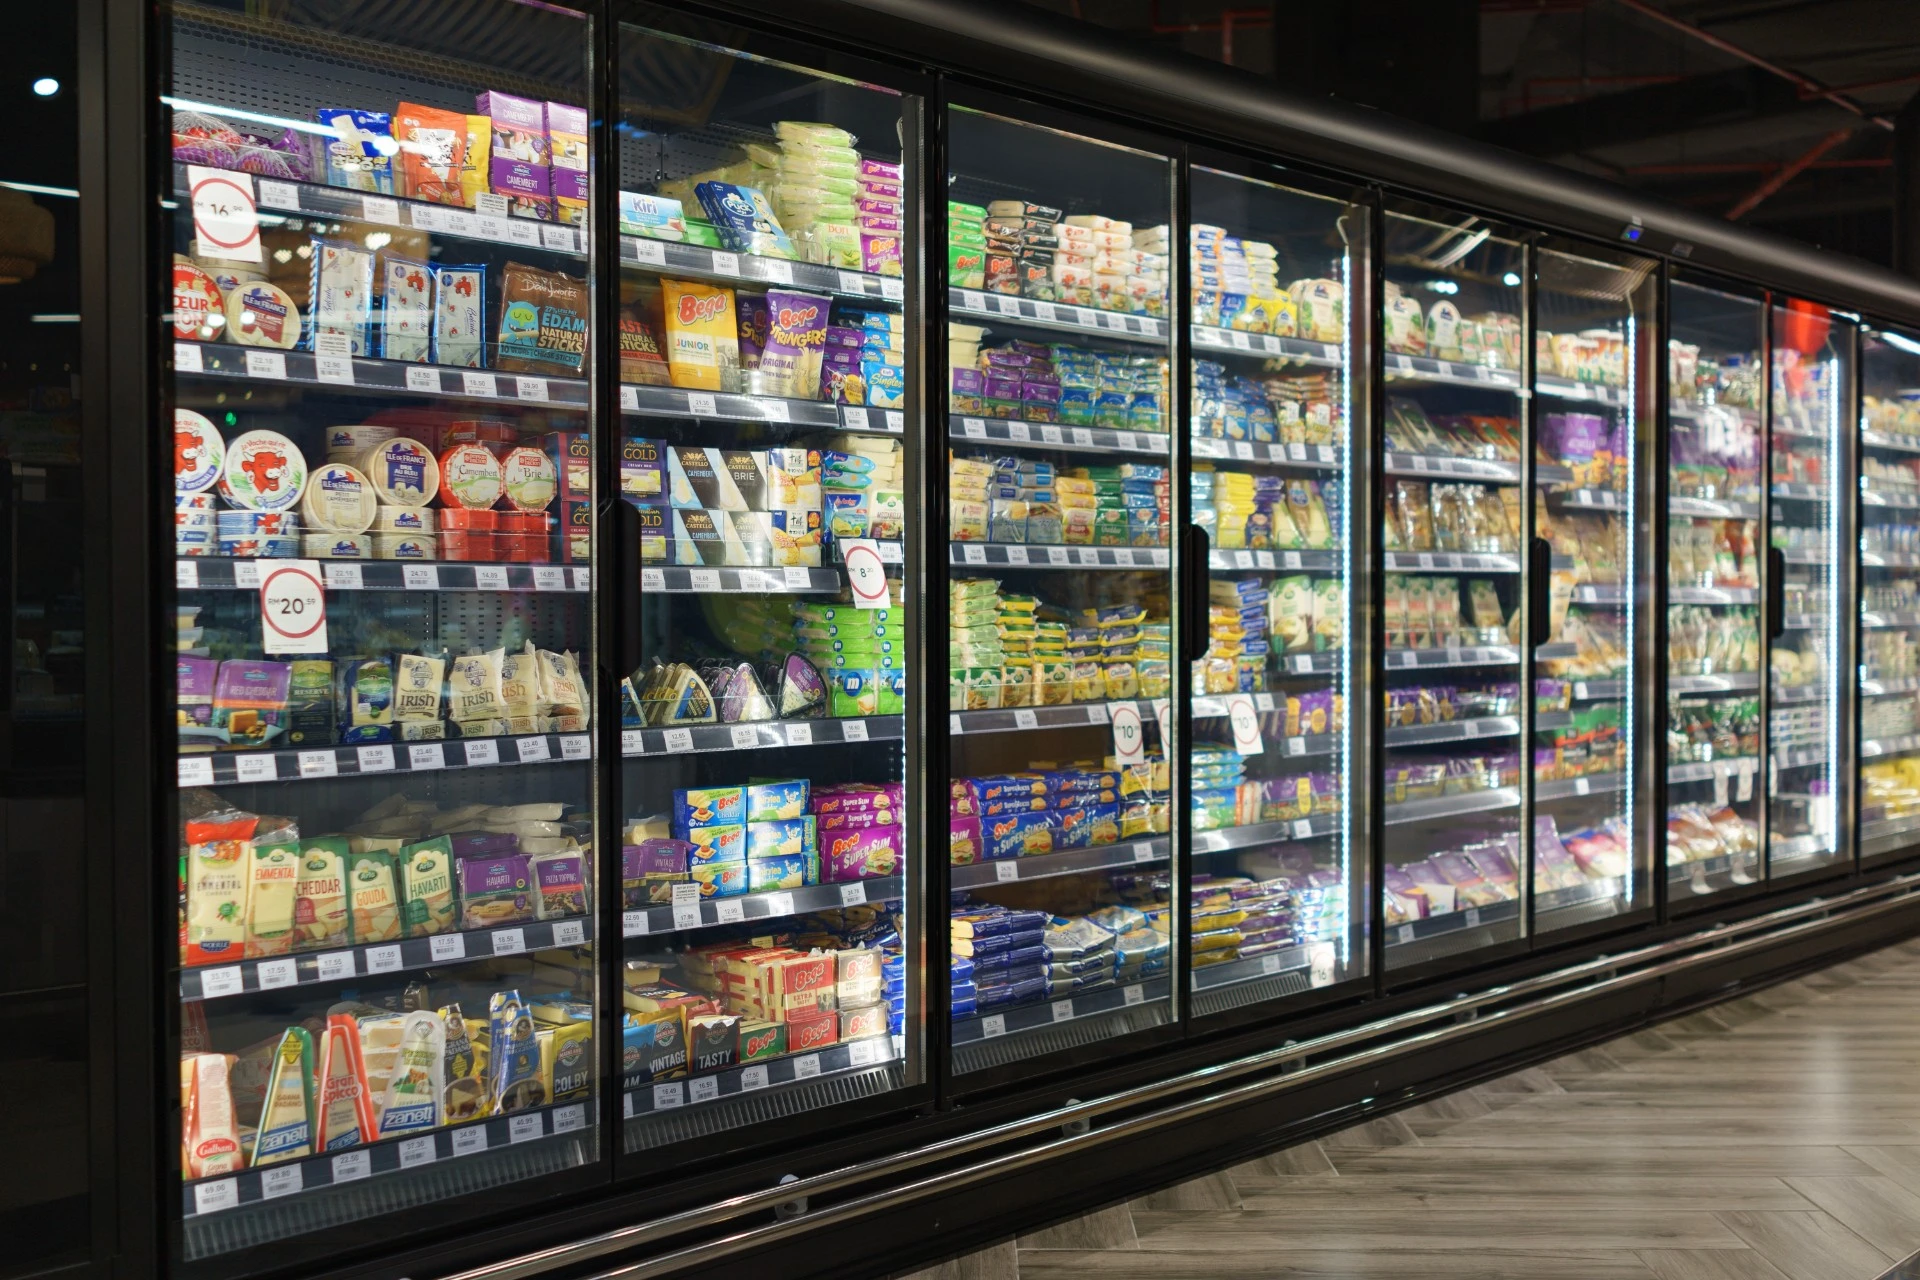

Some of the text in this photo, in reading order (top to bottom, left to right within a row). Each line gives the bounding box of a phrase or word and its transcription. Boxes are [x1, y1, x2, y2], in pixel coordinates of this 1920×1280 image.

[506, 175, 538, 190] CAMEMBERT
[210, 204, 229, 216] 16
[870, 238, 896, 255] Bega
[956, 254, 980, 270] Bega
[991, 258, 1013, 274] Bega
[1028, 266, 1047, 282] Bega
[261, 299, 288, 315] FRANCE
[678, 293, 727, 325] Bega
[542, 314, 586, 332] EDAM
[778, 306, 818, 331] Bega
[542, 326, 584, 342] NATURAL
[769, 320, 828, 347] STRINGERS
[538, 338, 583, 353] STICKS
[676, 338, 709, 350] JUNIOR
[762, 358, 794, 370] ORIGINAL
[386, 452, 396, 460] ILE
[402, 456, 426, 465] FRANCE
[624, 448, 657, 460] GOLD
[459, 464, 498, 478] Camembert
[524, 468, 542, 478] Brie
[688, 470, 714, 478] CAMEMBERT
[734, 472, 755, 480] BRIE
[338, 482, 360, 490] FRANCE
[692, 532, 718, 540] CAMEMBERT
[860, 568, 866, 578] 8
[280, 598, 304, 614] 20
[294, 688, 329, 696] RESERVE
[1238, 716, 1250, 730] 10
[1122, 726, 1134, 739] 10
[718, 794, 740, 810] Bega
[822, 799, 839, 813] Bega
[826, 815, 844, 830] Bega
[1063, 809, 1086, 832] Bega
[950, 829, 970, 844] SLIM
[994, 817, 1018, 841] Bega
[720, 830, 741, 848] Bega
[832, 832, 860, 858] Bega
[1000, 822, 1050, 854] SUPER SLICES
[844, 836, 891, 870] SUPER SLIM
[418, 862, 434, 871] Arla
[655, 858, 674, 868] VINTAGE
[256, 867, 296, 880] EMMENTAL
[486, 874, 510, 886] HAVARTI
[546, 873, 577, 884] PIZZA TOPPING
[296, 878, 341, 896] CHEDDAR
[410, 875, 447, 898] HAVARTI
[356, 888, 387, 906] GOUDA
[563, 926, 578, 934] 12.75
[846, 953, 874, 980] Bega
[1316, 968, 1327, 980] 16
[794, 962, 825, 992] Bega
[794, 992, 812, 1002] EXTRA
[849, 1008, 878, 1036] Bega
[800, 1018, 830, 1048] Bega
[746, 1028, 777, 1058] Bega
[650, 1050, 686, 1074] VINTAGE
[699, 1049, 732, 1070] TASTY
[326, 1076, 355, 1088] Gran
[554, 1070, 588, 1093] COLBY
